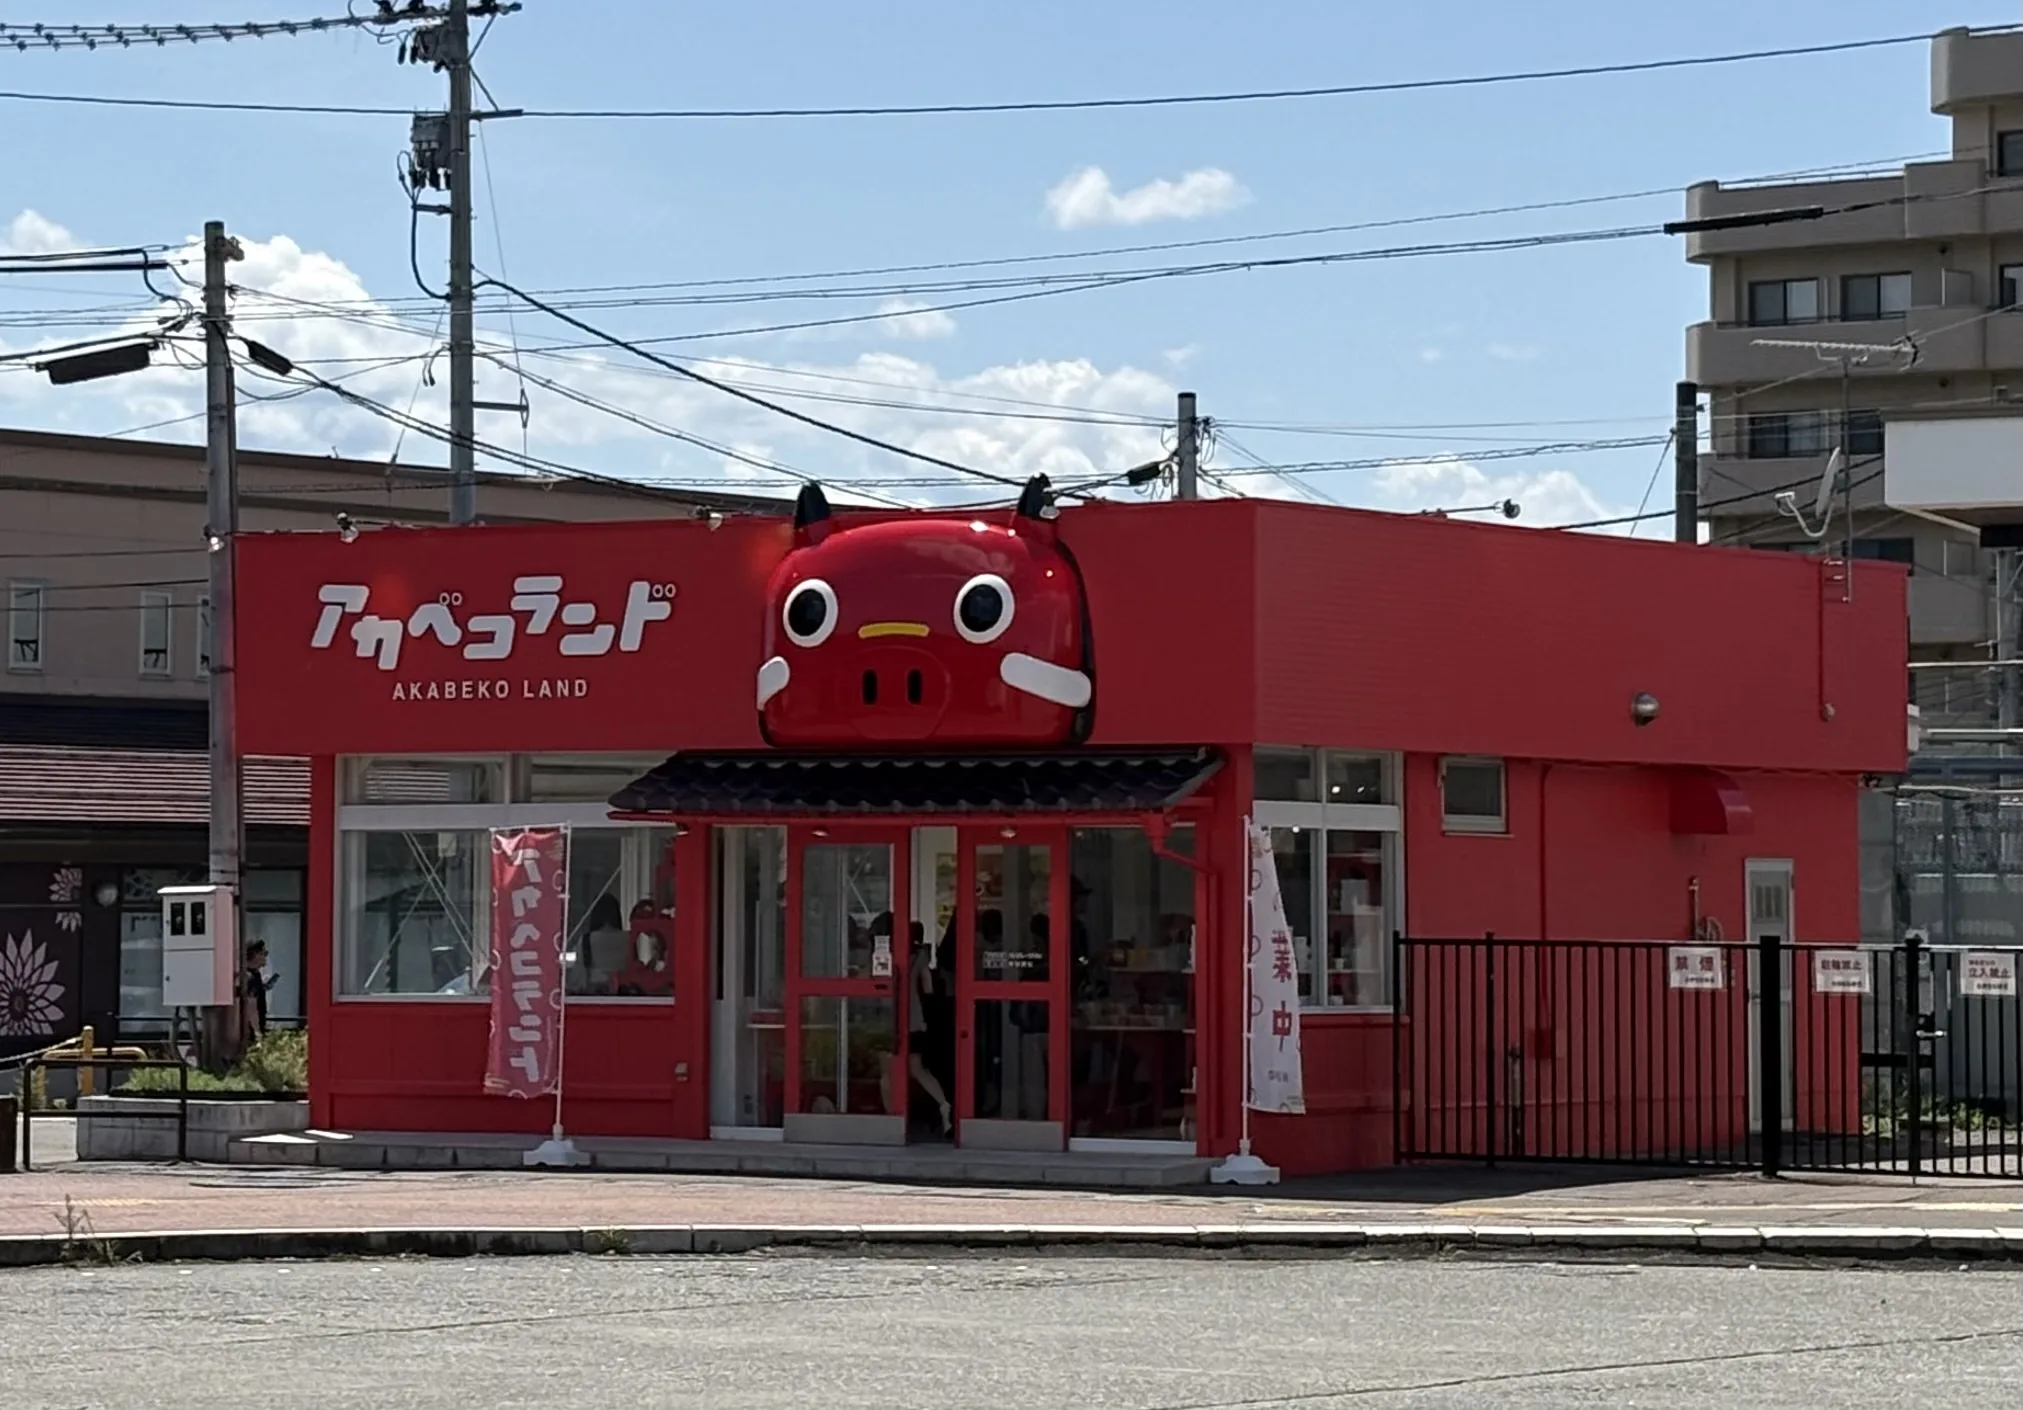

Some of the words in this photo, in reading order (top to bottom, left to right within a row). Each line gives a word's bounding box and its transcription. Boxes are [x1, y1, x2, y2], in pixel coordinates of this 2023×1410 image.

[310, 576, 677, 670] アカベコランド
[392, 680, 510, 701] AKABEKO
[523, 679, 589, 698] LAND
